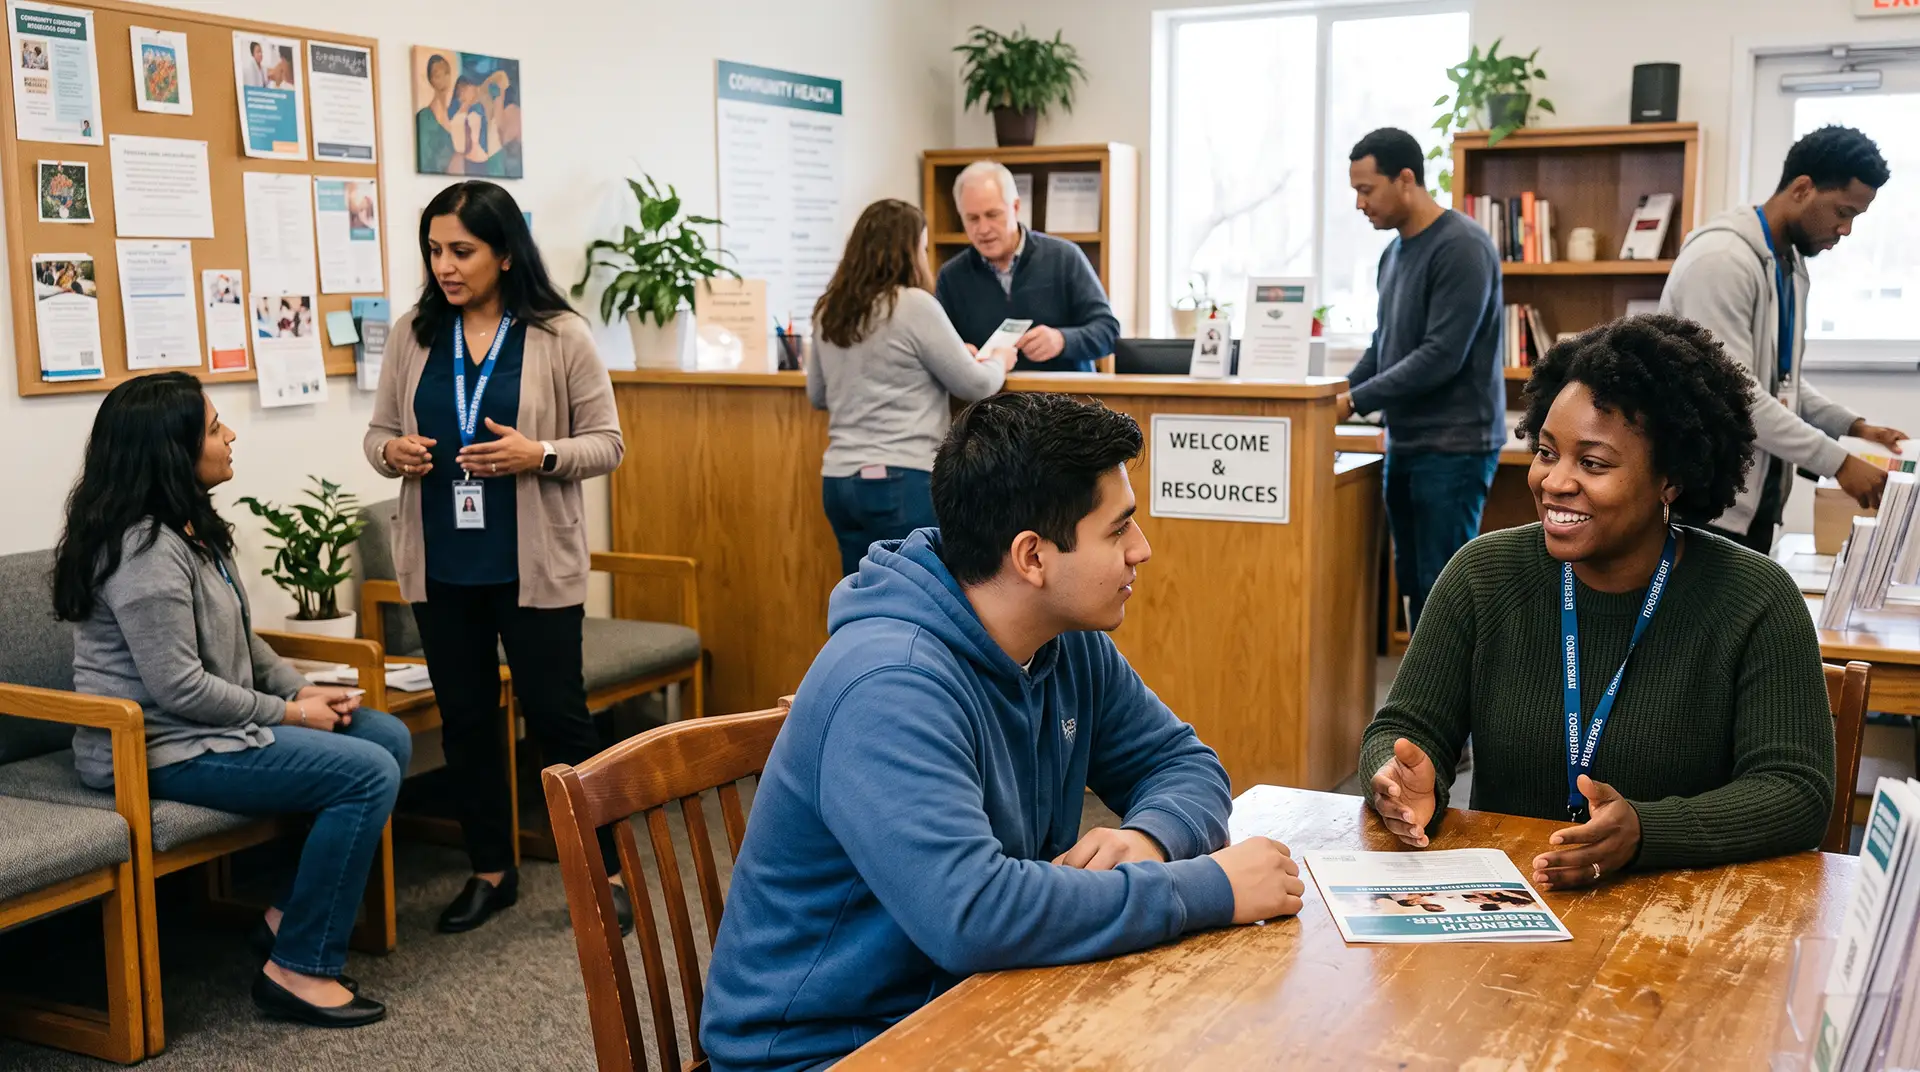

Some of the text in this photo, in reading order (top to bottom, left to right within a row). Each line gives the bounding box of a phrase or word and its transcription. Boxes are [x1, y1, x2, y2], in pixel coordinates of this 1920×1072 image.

[728, 72, 834, 105] COMMUNITY HEALTH
[1170, 432, 1270, 452] WELCOME
[1212, 459, 1226, 475] &
[1162, 482, 1278, 503] RESOURCES
[1441, 920, 1550, 932] STRENGTH
